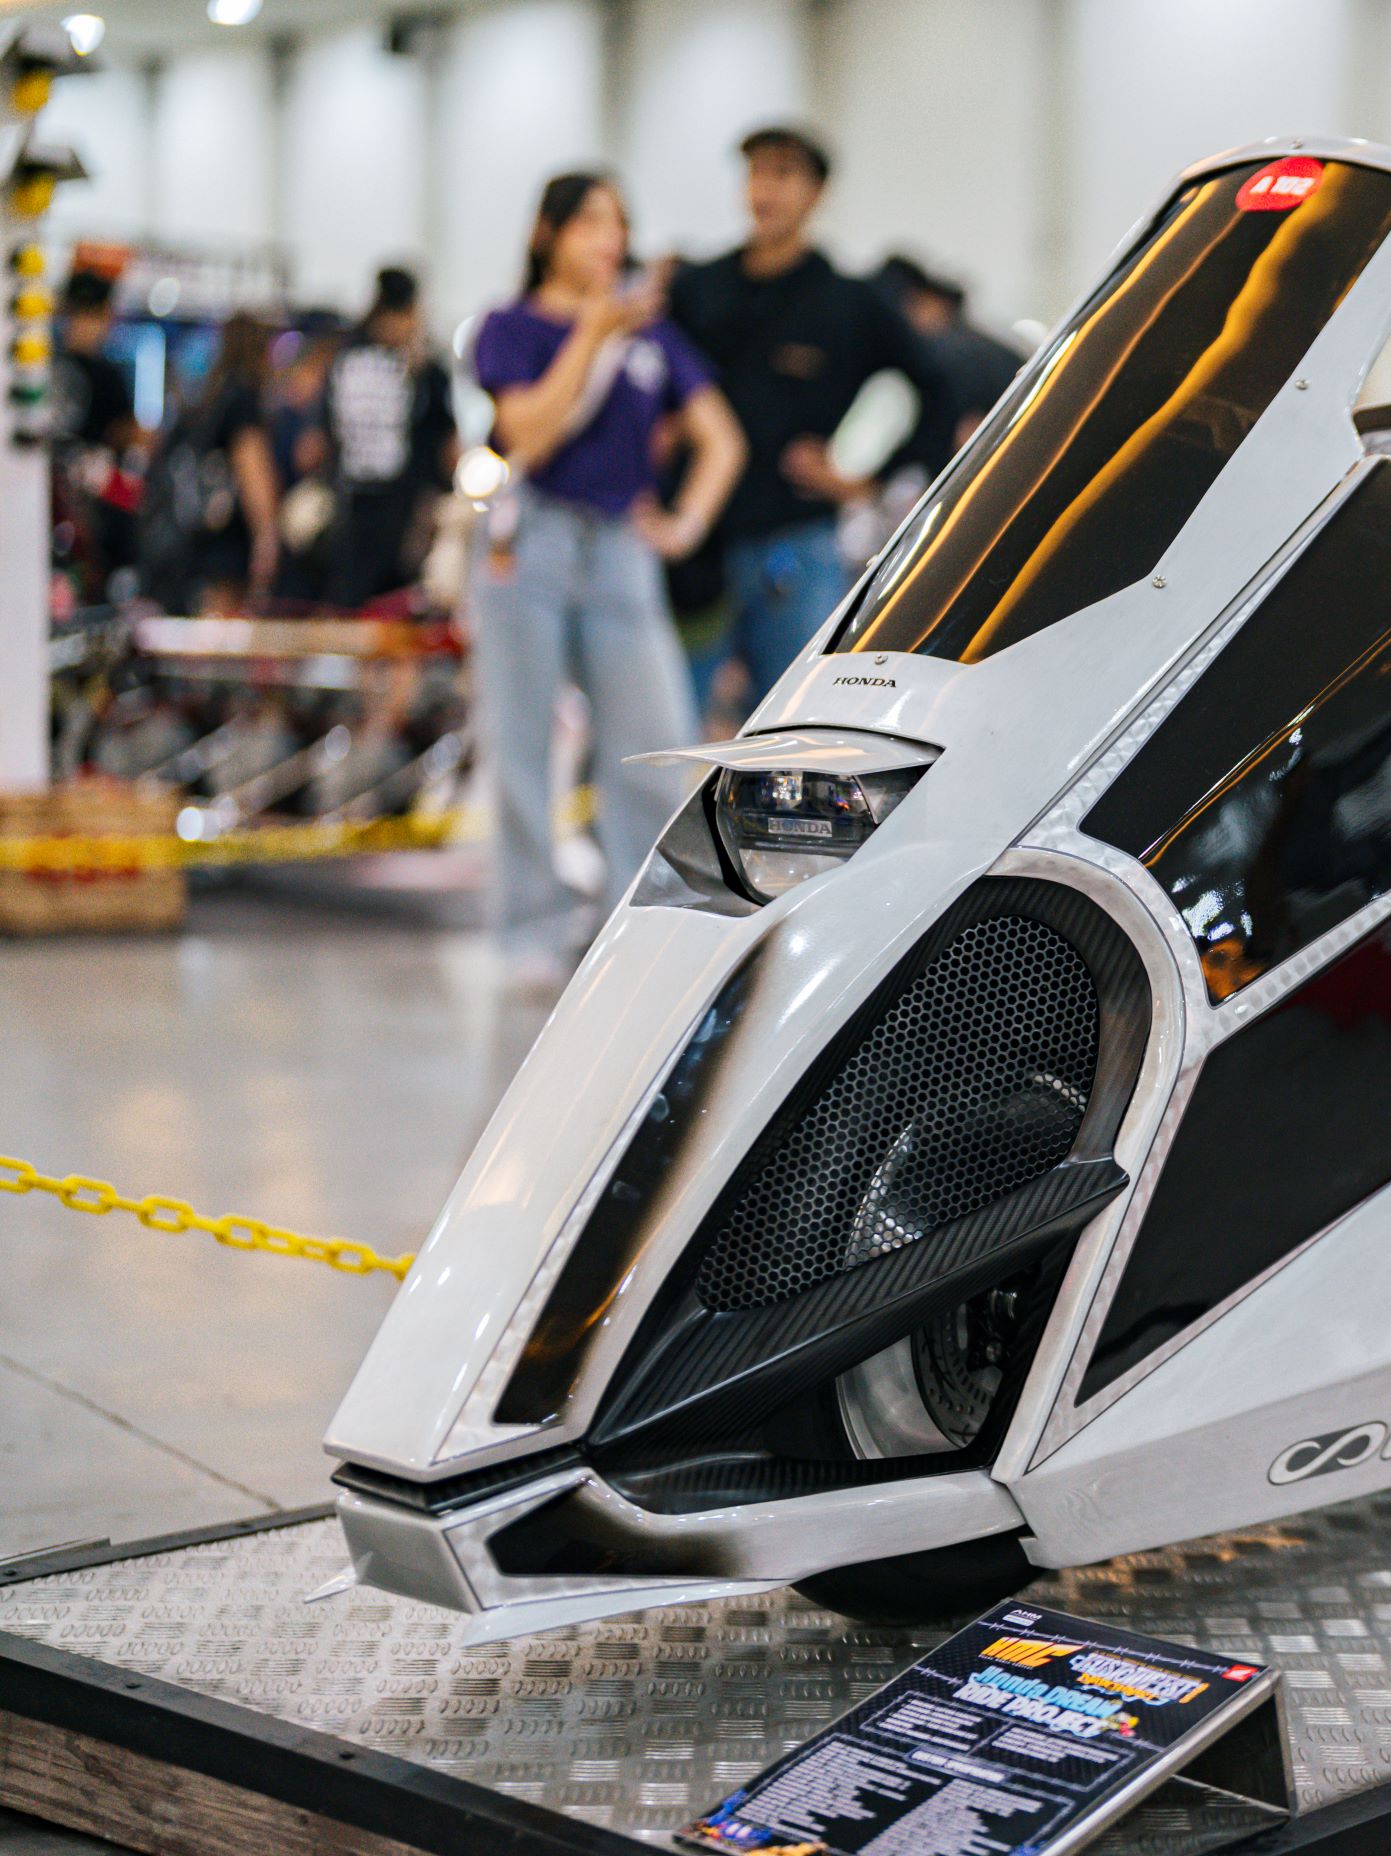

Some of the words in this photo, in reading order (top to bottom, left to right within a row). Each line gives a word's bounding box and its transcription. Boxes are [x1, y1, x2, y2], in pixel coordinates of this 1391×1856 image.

[832, 677, 896, 688] HONDA
[769, 820, 832, 836] HONDA
[952, 1681, 1013, 1709] RIDE
